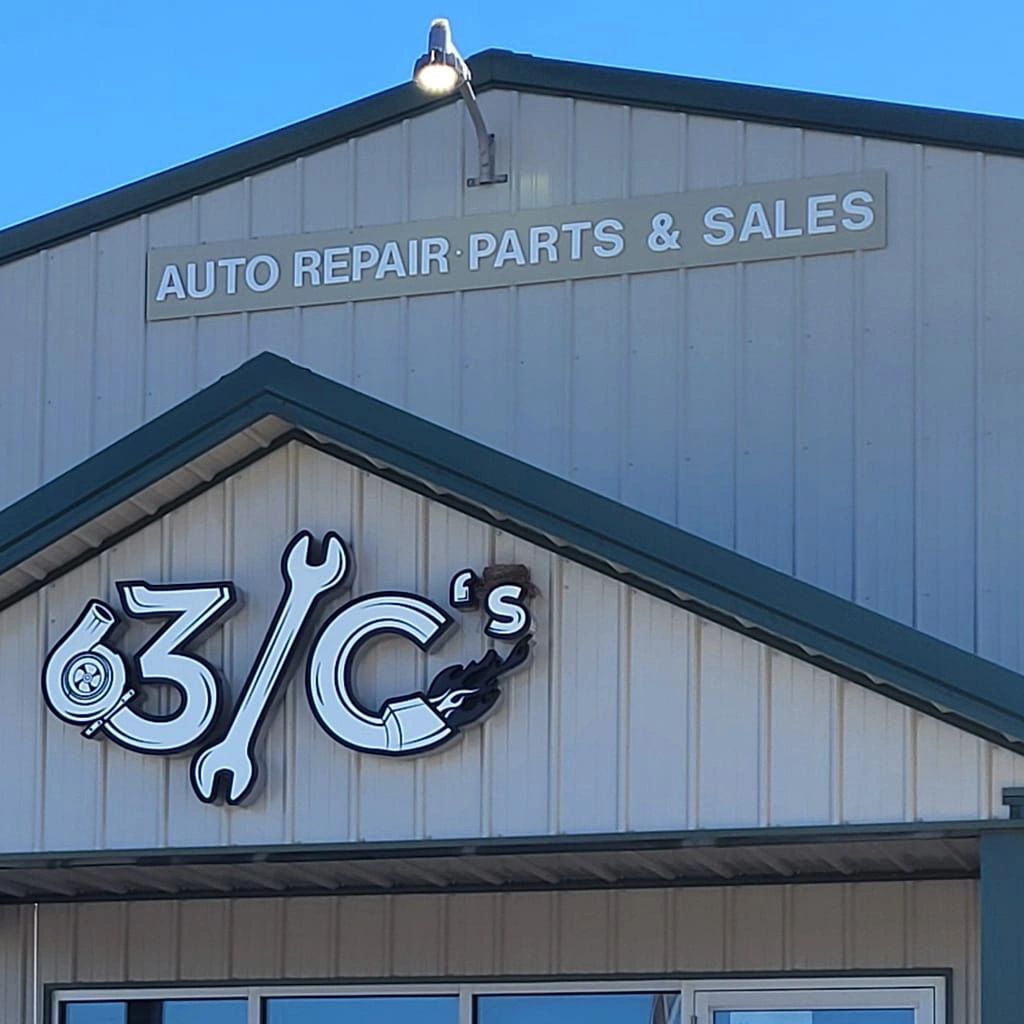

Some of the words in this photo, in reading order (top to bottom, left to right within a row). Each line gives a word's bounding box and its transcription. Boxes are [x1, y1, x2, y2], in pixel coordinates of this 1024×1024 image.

[155, 254, 278, 301] AUTO
[293, 235, 449, 288] REPAIR
[468, 218, 626, 270] PARTS
[647, 211, 682, 252] &
[702, 190, 876, 248] SALES
